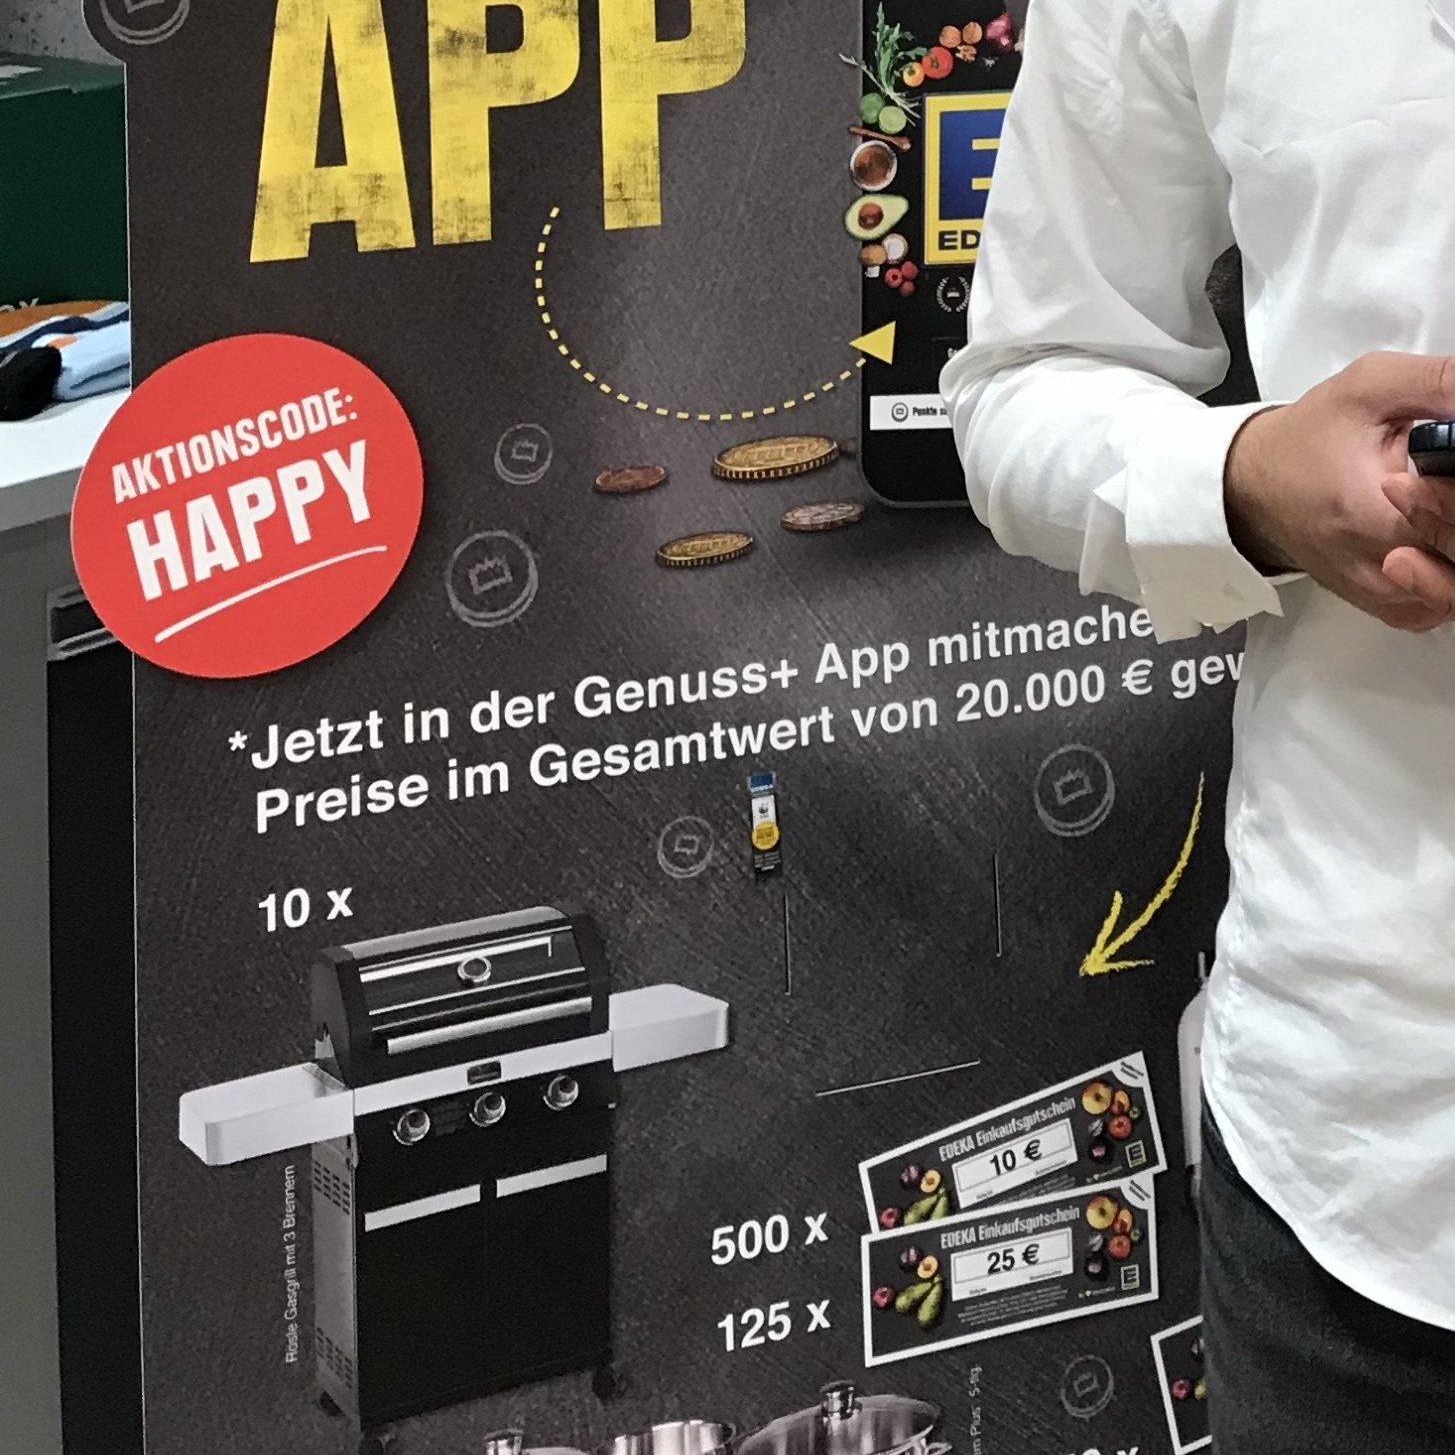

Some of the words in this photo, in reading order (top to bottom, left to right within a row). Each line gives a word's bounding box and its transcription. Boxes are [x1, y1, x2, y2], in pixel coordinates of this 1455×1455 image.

[112, 387, 358, 504] AKTIONSCODE:
[127, 439, 370, 601] HAPPY
[404, 702, 449, 744] in
[470, 690, 555, 733] der
[574, 658, 798, 718] Genuss+
[815, 642, 910, 689] App
[256, 774, 428, 834] Preise
[448, 758, 509, 800] im
[529, 705, 834, 788] Gesamtwert
[851, 696, 938, 737] von
[956, 665, 1105, 722] 20.000
[1122, 659, 1153, 695] €
[259, 887, 310, 932] 10
[326, 887, 353, 920] x
[939, 1134, 975, 1162] EDEKA
[976, 1096, 1077, 1146] Einkaufsgutschein
[990, 1148, 1016, 1176] 10
[1023, 1139, 1042, 1161] €
[283, 1231, 296, 1242] 3
[711, 1214, 790, 1265] 500
[804, 1212, 829, 1245] x
[941, 1230, 976, 1249] EDEKA
[979, 1205, 1080, 1241] Einkaufsgutschein
[285, 1244, 296, 1265] mit
[987, 1248, 1015, 1275] 25
[1022, 1243, 1040, 1265] €
[717, 1301, 792, 1352] 125
[807, 1299, 831, 1333] x
